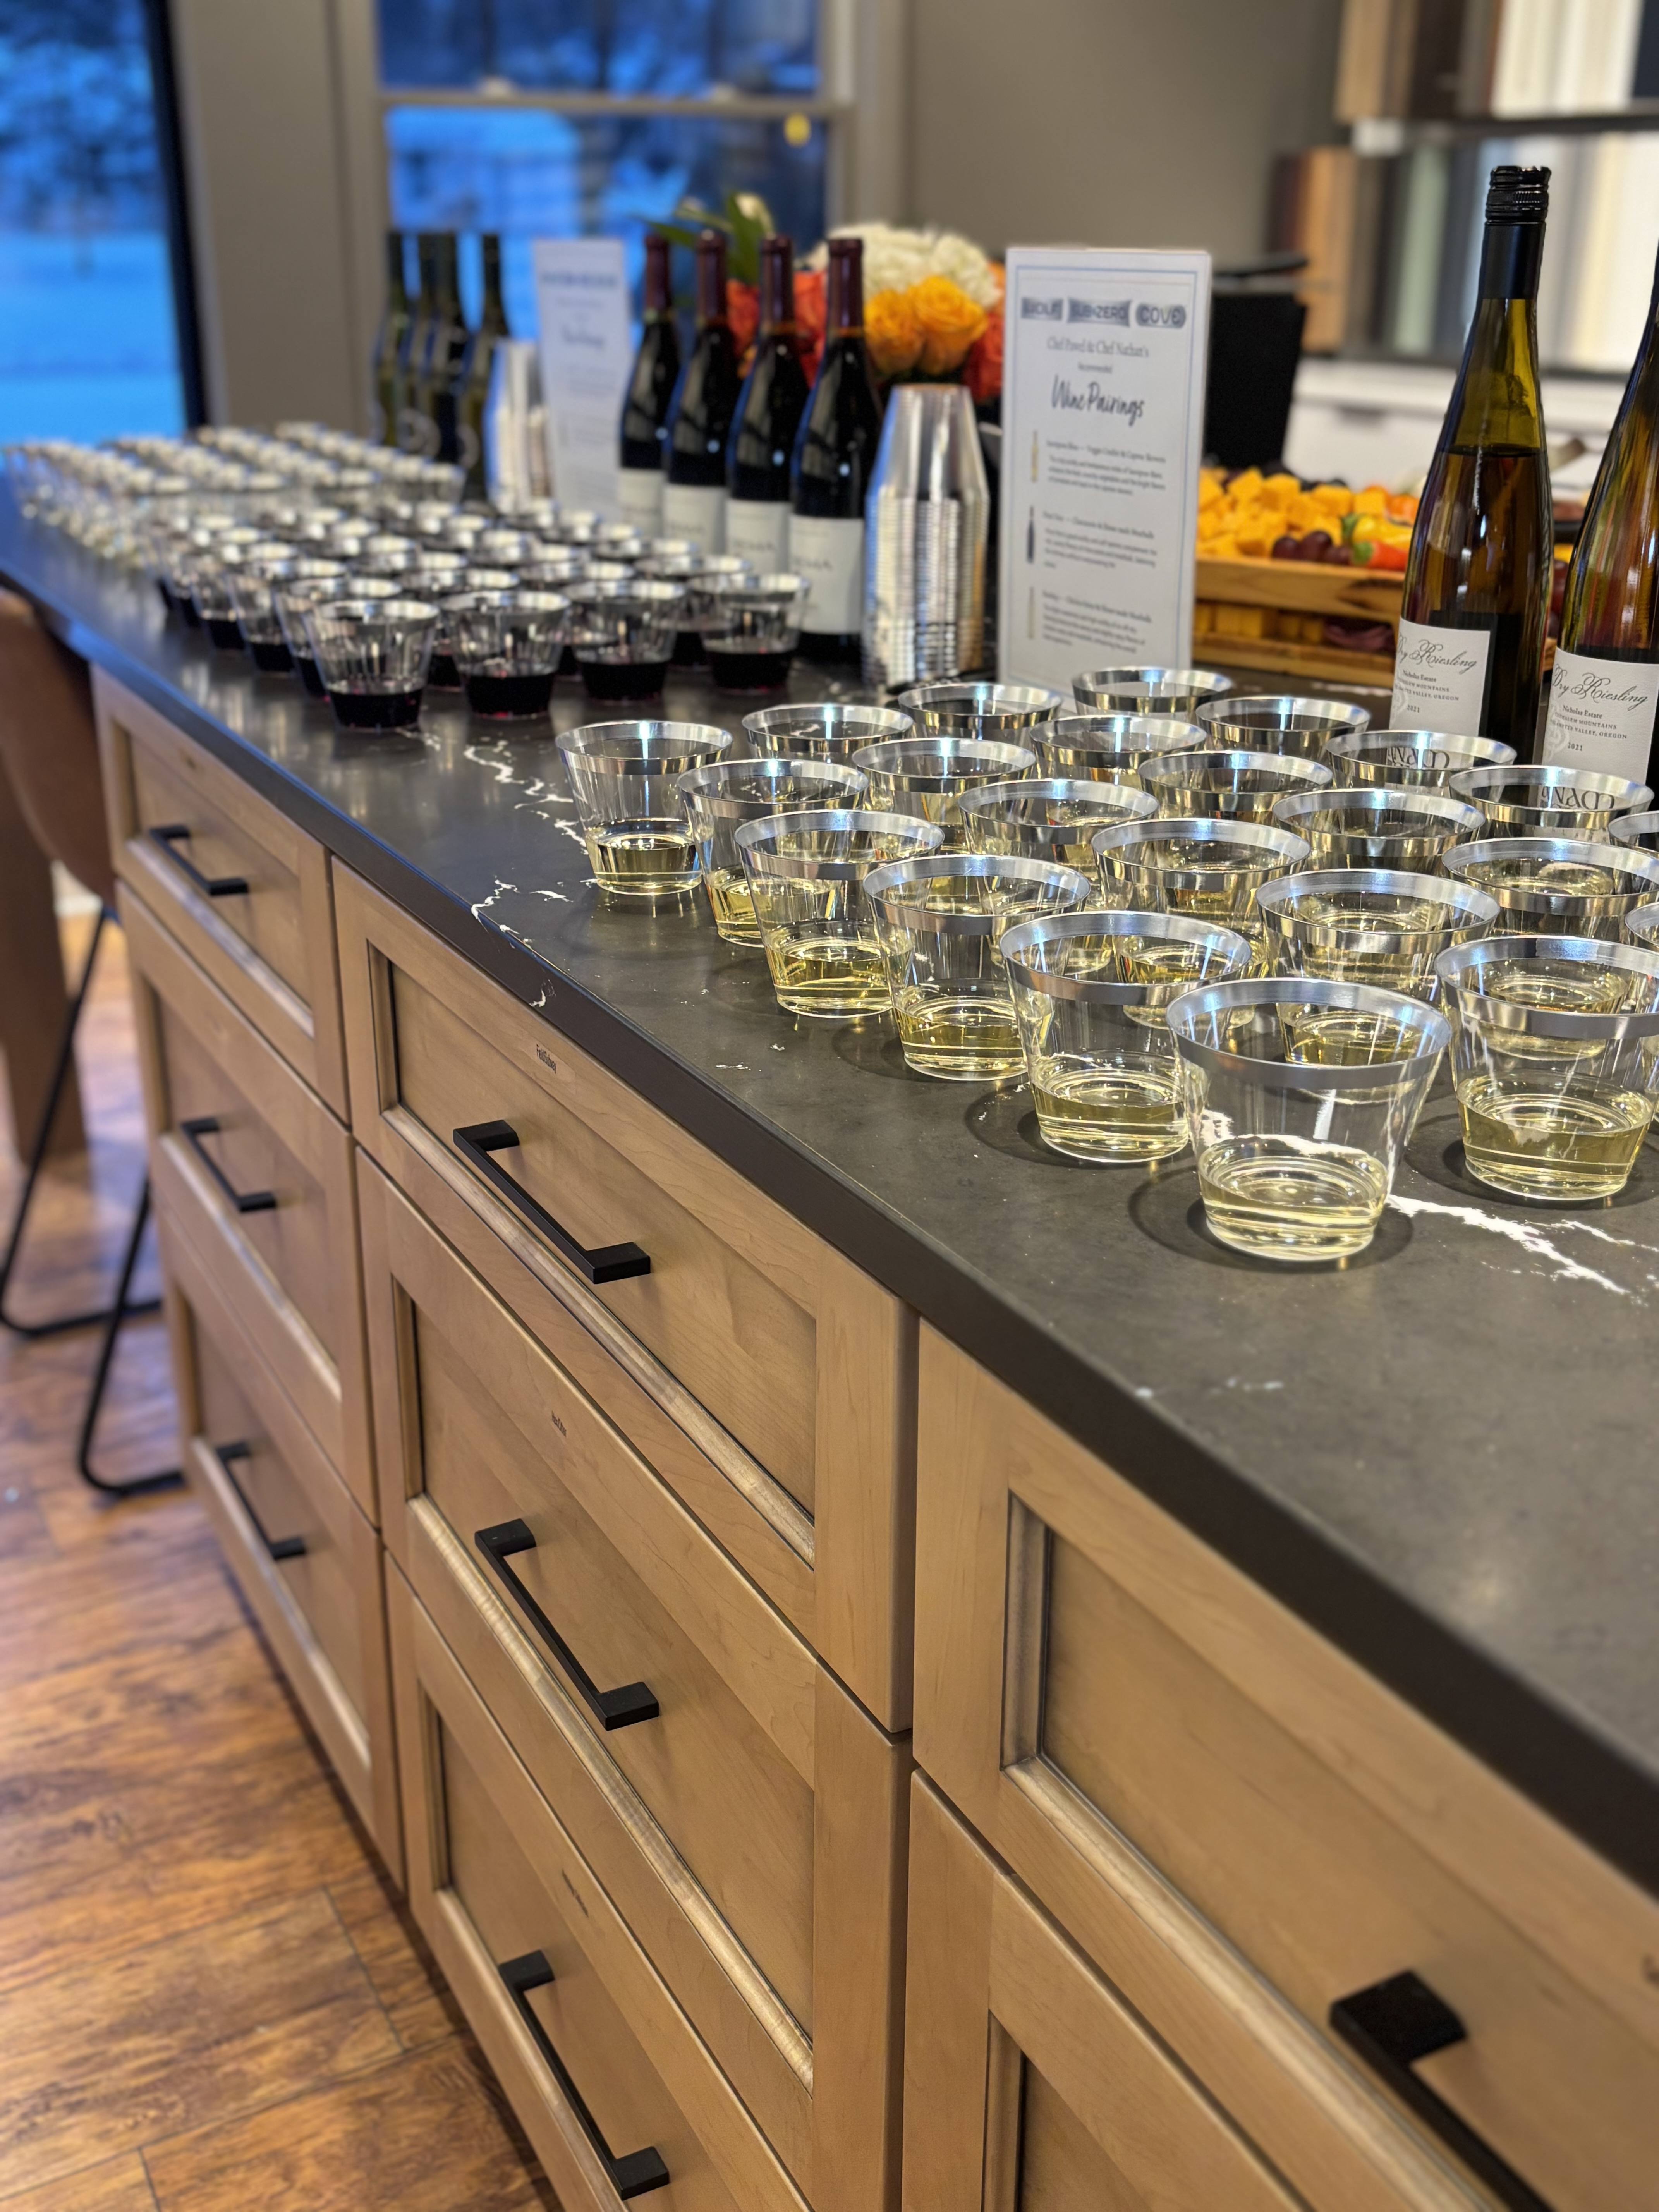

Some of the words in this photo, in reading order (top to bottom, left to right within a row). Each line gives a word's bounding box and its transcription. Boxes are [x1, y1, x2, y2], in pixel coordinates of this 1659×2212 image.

[1051, 374, 1084, 411] Wine
[1087, 380, 1145, 427] Pairings
[1408, 639, 1477, 675] Riesling
[1553, 663, 1569, 698] Dry
[1571, 672, 1648, 711] Riesling
[1579, 720, 1617, 730] MOUNTAINS
[1599, 731, 1627, 739] OREGON
[1567, 742, 1583, 751] 2021
